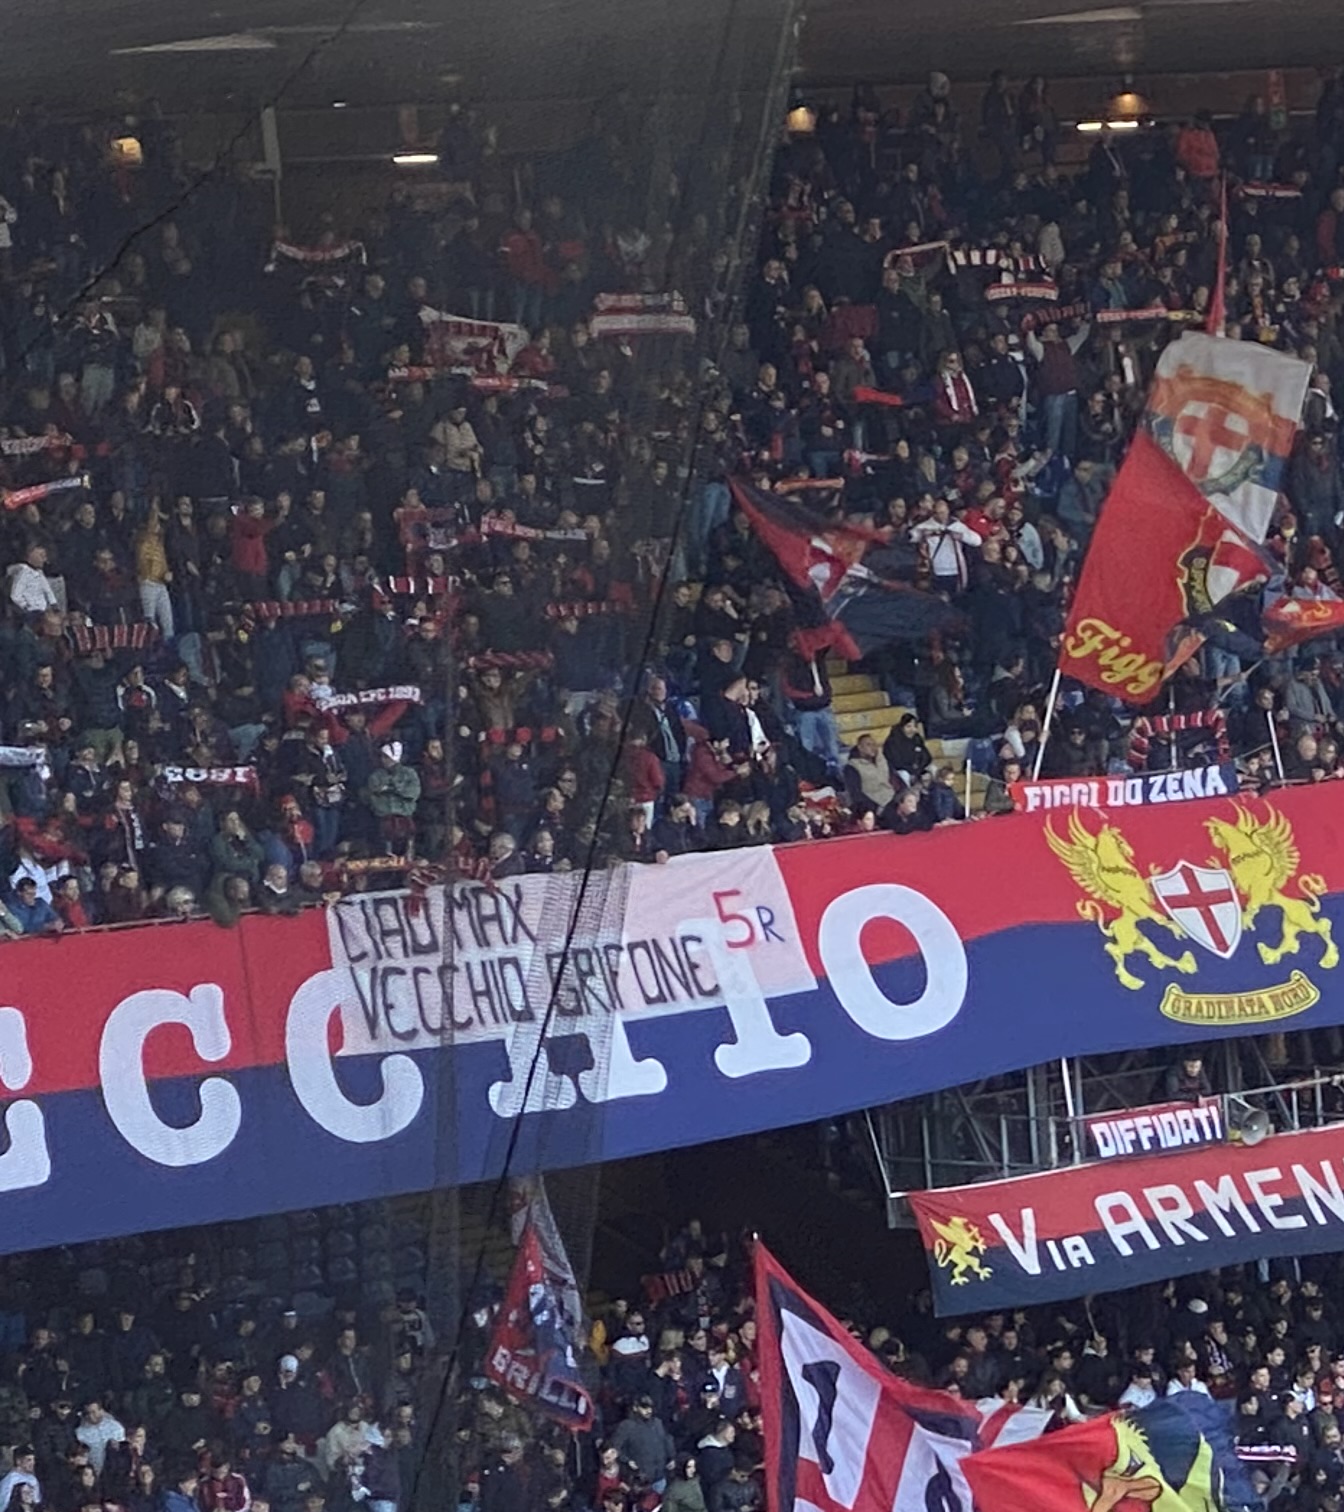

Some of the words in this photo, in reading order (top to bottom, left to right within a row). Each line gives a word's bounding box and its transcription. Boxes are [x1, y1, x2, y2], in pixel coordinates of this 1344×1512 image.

[1023, 784, 1097, 813] FIGGI
[1103, 779, 1142, 809] DO
[1147, 766, 1225, 804] ZENA
[336, 899, 440, 962] CIAO
[443, 882, 537, 947] MAX
[348, 954, 537, 1042] VECCHIO
[547, 933, 723, 1020] GRIFONE
[1091, 1105, 1222, 1158] DIFFIDATI
